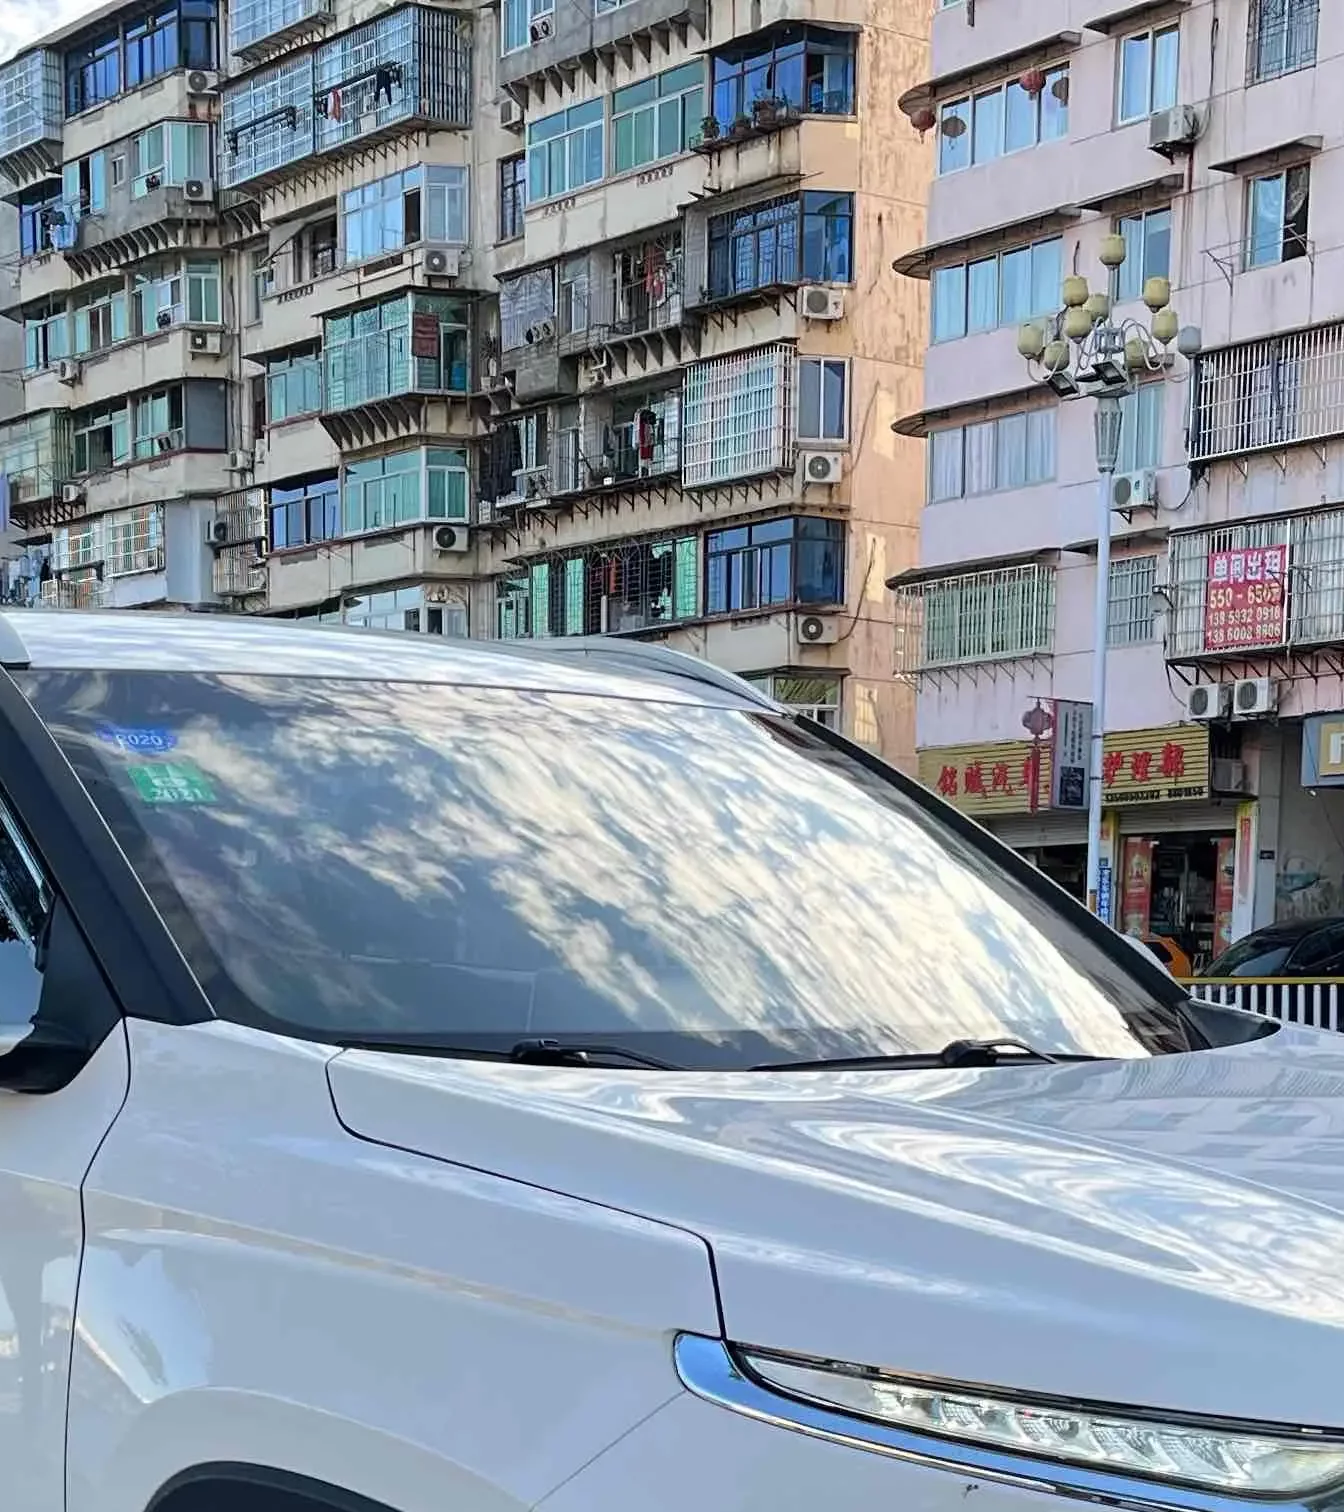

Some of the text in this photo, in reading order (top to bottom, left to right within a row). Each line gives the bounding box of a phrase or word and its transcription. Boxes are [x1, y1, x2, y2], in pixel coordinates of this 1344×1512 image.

[1213, 550, 1281, 584] 单间出租
[1209, 586, 1233, 609] 550
